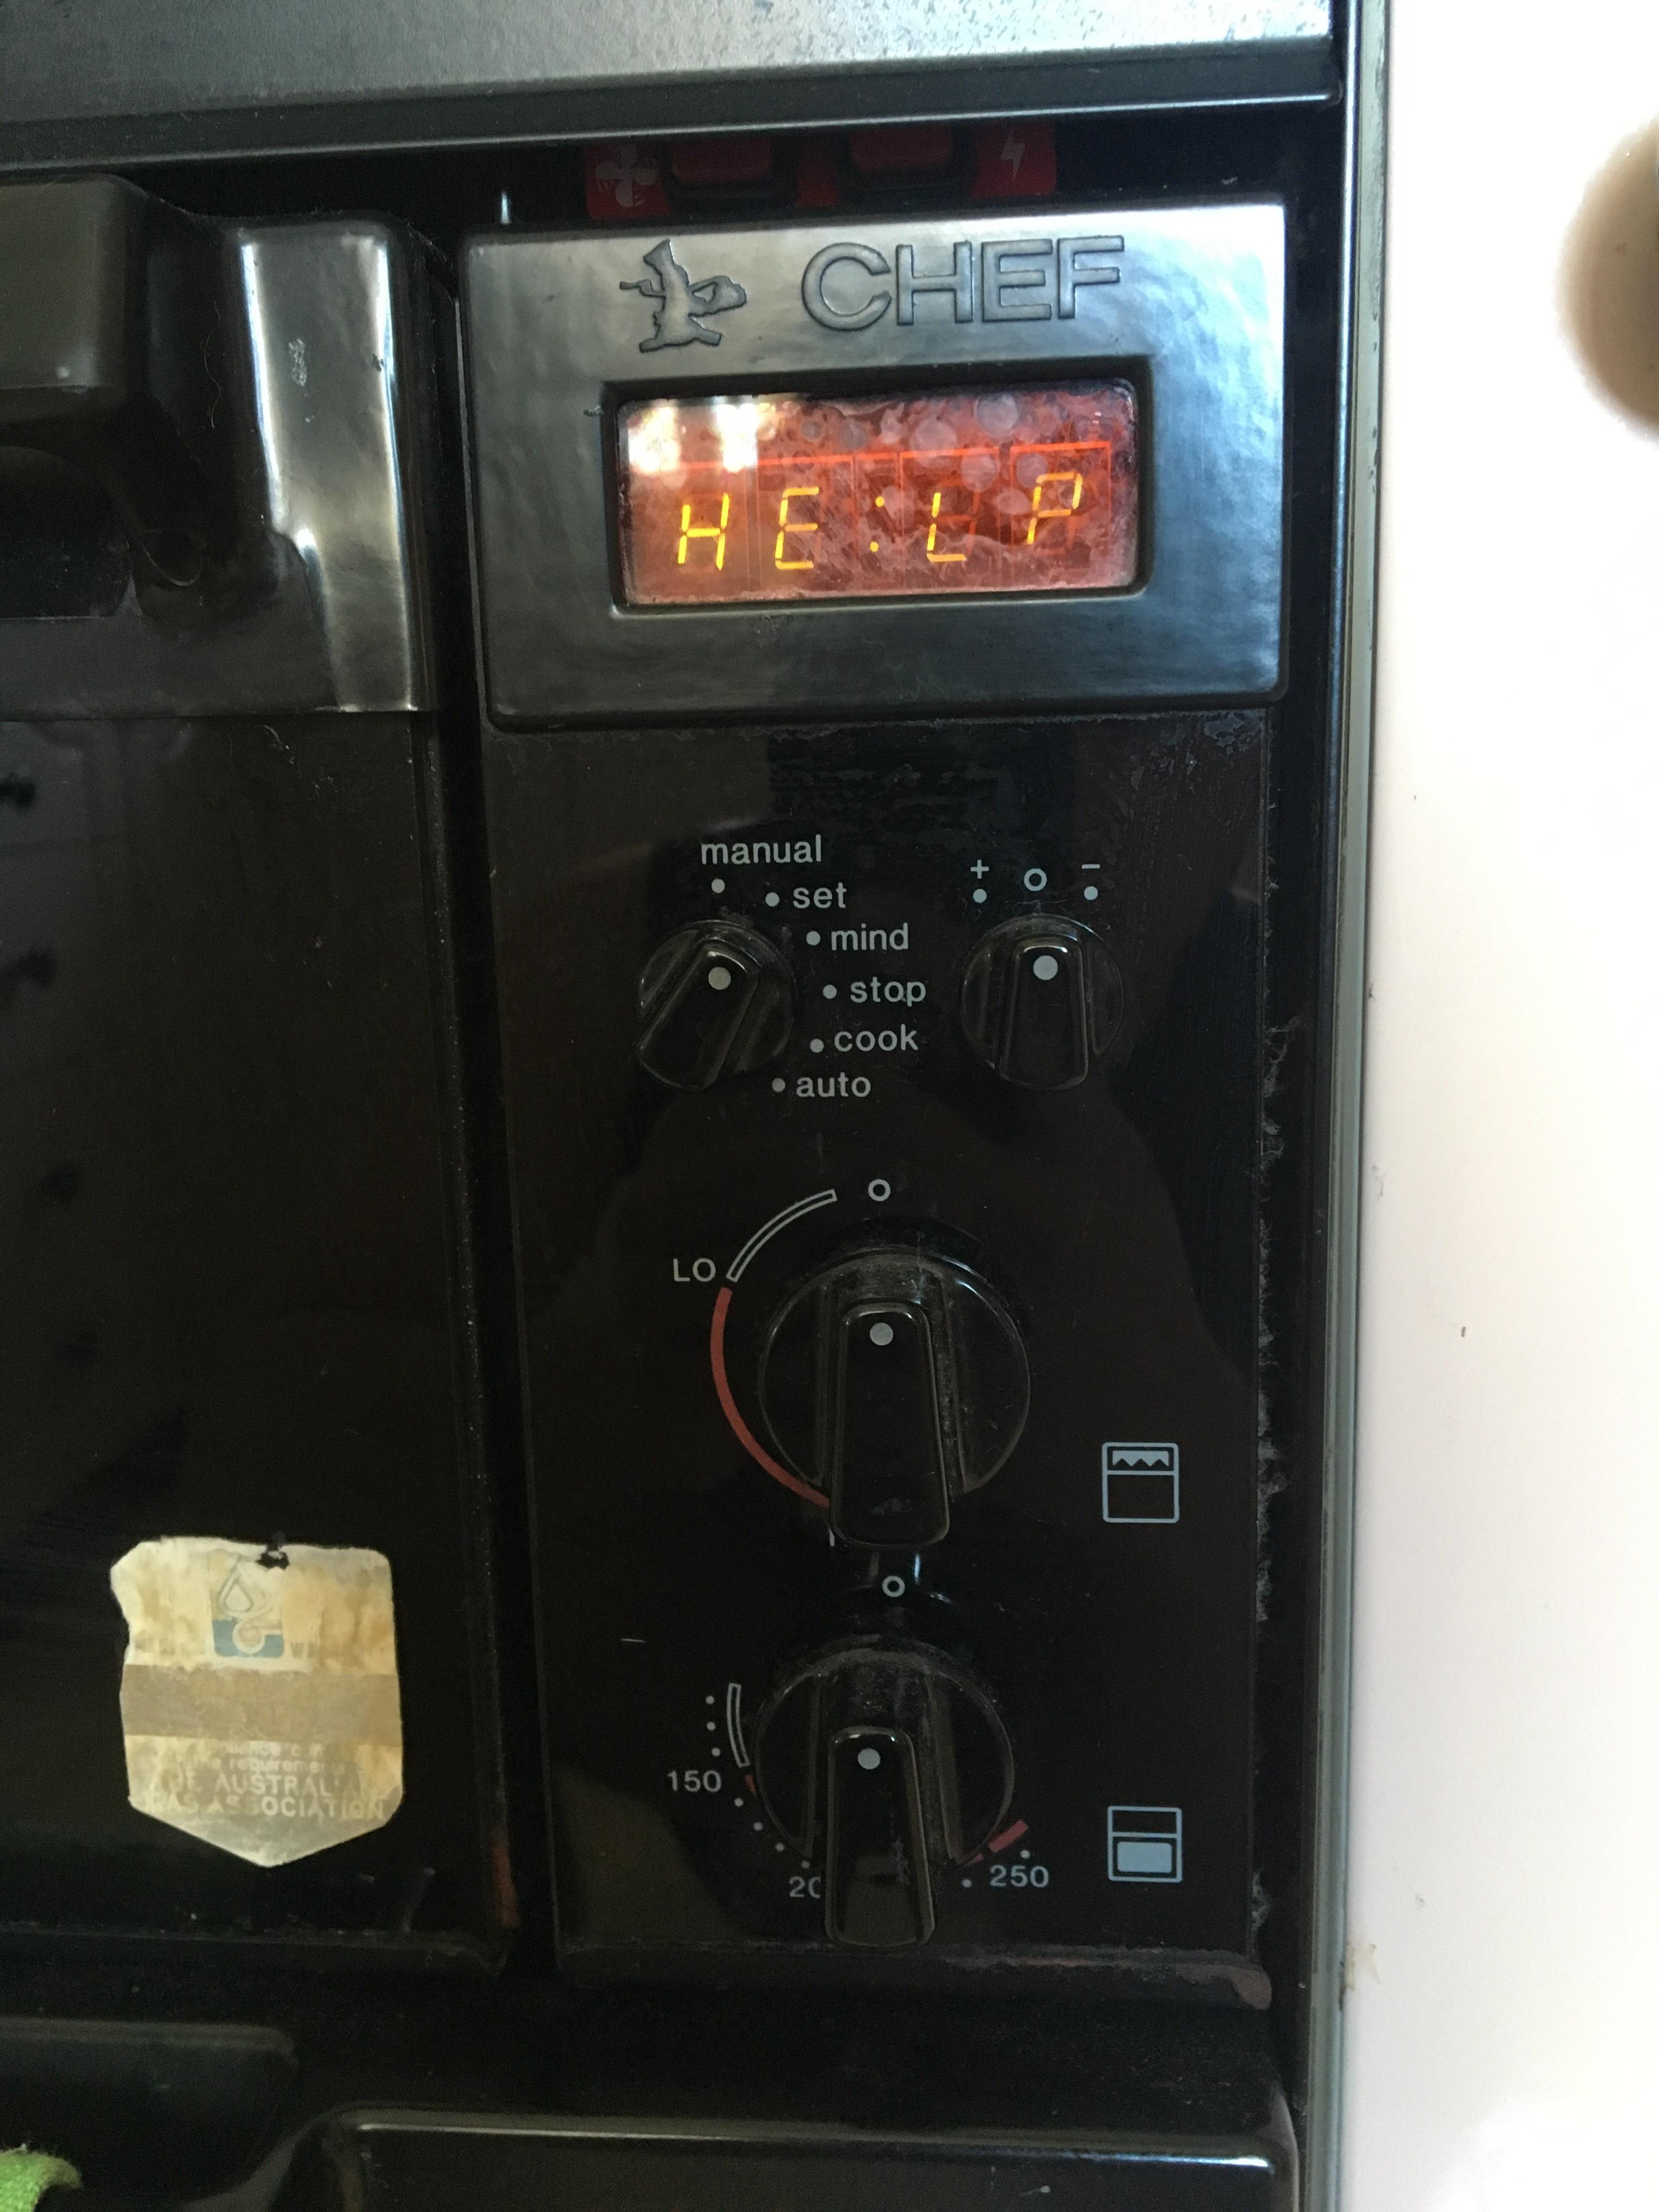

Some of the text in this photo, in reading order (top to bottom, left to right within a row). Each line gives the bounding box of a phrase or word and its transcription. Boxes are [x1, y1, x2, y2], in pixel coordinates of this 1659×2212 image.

[800, 235, 1125, 331] CHEF
[700, 833, 822, 865] manual
[792, 880, 848, 910] set
[830, 922, 910, 951] mind
[849, 978, 927, 1007] stop
[833, 1023, 919, 1053] cook
[795, 1073, 872, 1098] auto
[672, 1256, 716, 1283] LO
[667, 1769, 723, 1793] 150
[788, 1875, 821, 1899] 20
[989, 1864, 1050, 1888] 250
